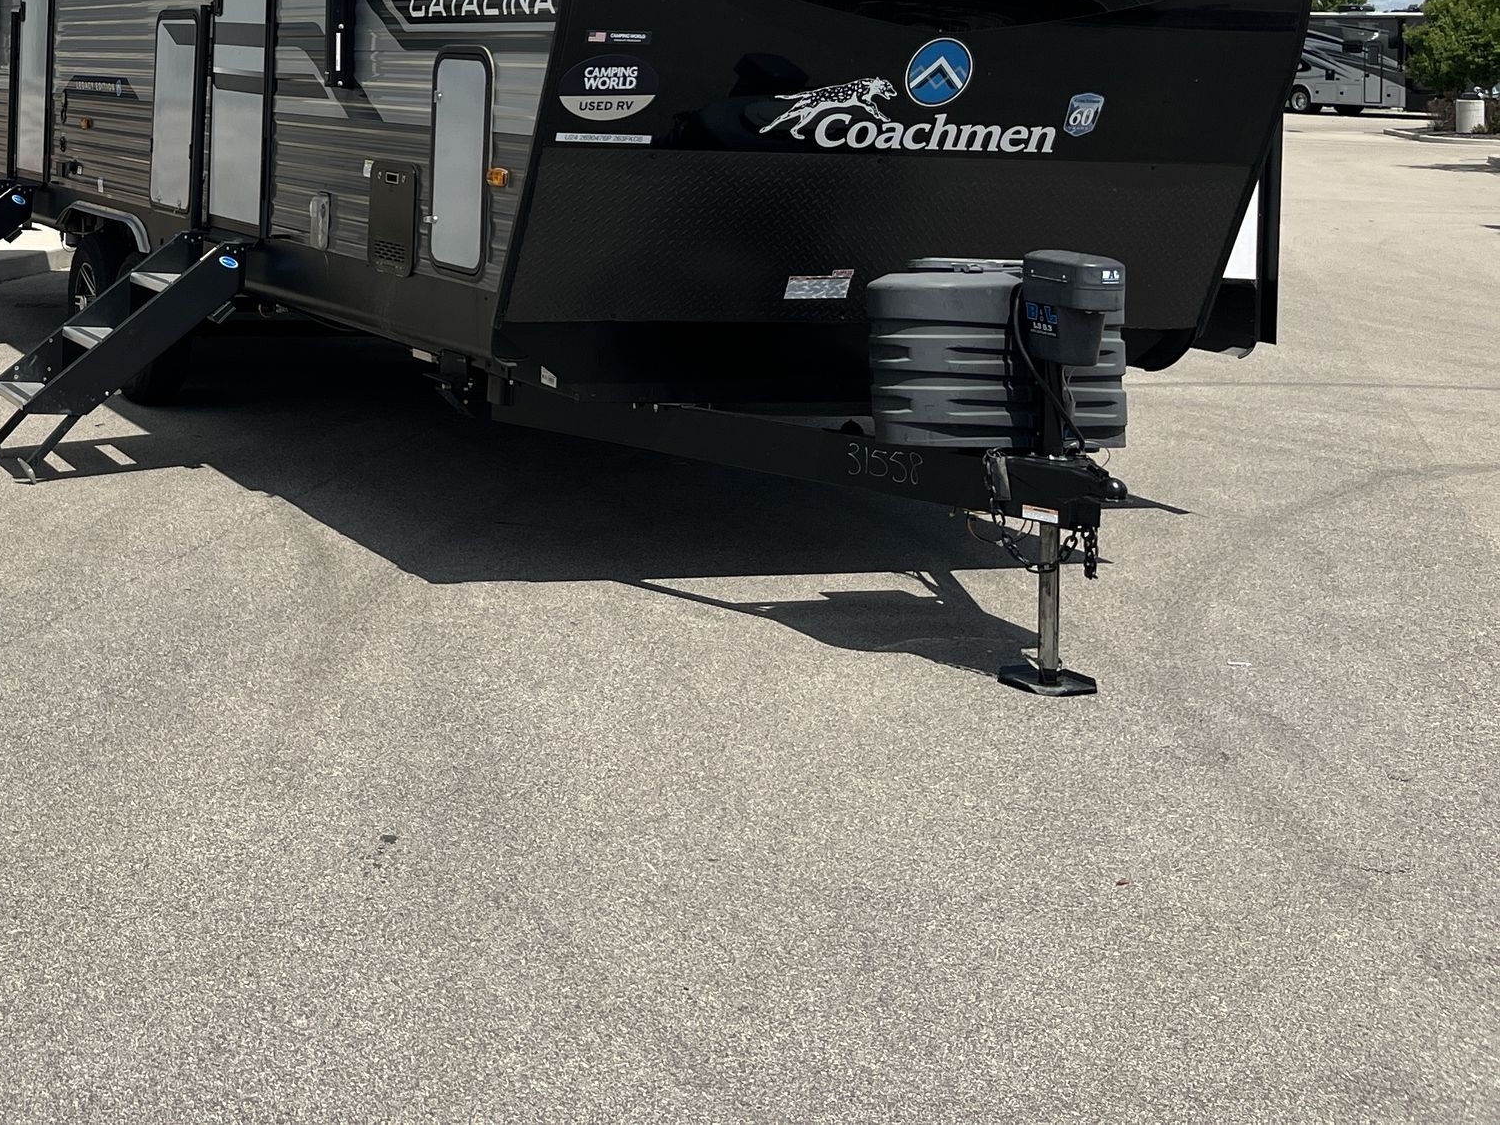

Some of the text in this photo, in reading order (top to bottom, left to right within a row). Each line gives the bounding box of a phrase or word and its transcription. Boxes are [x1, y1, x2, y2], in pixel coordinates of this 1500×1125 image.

[584, 66, 638, 78] CAMPING
[584, 77, 637, 90] WORLD
[579, 101, 634, 111] USED RV
[1069, 107, 1095, 126] 60
[814, 113, 1056, 153] Coachmen
[847, 442, 924, 485] 31558
